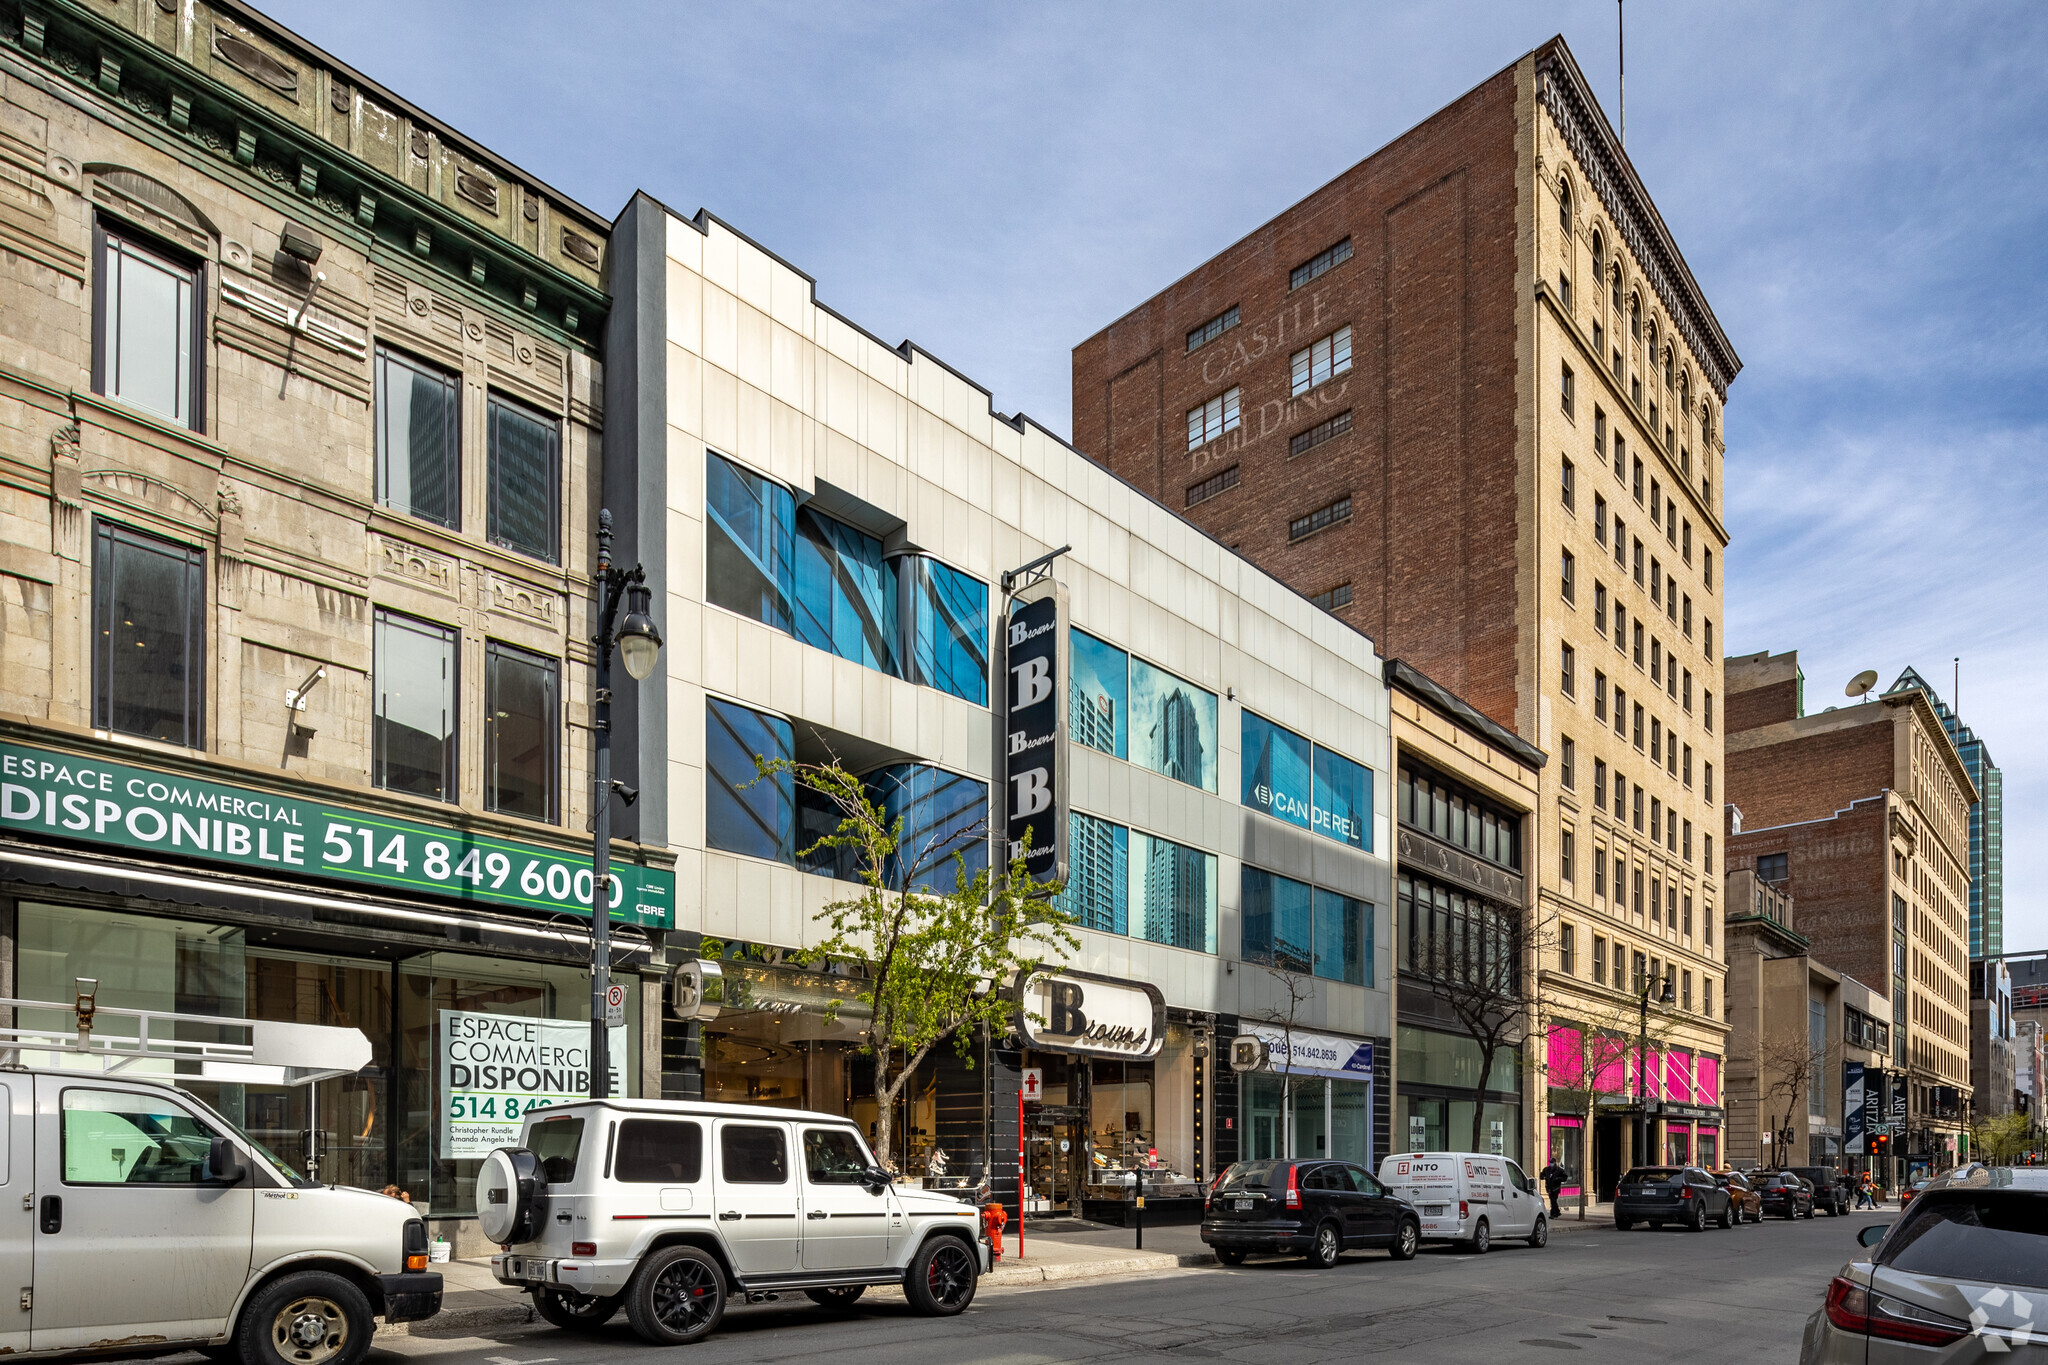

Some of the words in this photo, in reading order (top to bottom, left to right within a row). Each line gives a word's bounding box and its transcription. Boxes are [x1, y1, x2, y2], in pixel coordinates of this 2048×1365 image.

[1008, 620, 1056, 648] Browns
[1011, 655, 1052, 713] B
[1008, 730, 1056, 756] Browns
[3, 754, 113, 792] ESPACE
[126, 778, 303, 827] COMMERCIAL
[1010, 766, 1052, 821] B
[1, 782, 304, 866] DISPONIBLE
[1275, 791, 1360, 840] CANDEREL
[322, 823, 409, 874] 514
[422, 841, 511, 890] 849
[520, 860, 623, 909] 6000
[1008, 839, 1056, 864] Browns
[635, 903, 666, 917] CBRE
[675, 971, 698, 1008] B
[1040, 978, 1148, 1045] Browns
[450, 1016, 536, 1043] ESPACE
[449, 1040, 617, 1069] COMMERCIL
[1292, 1045, 1338, 1061] 514.842.8636
[450, 1063, 619, 1094] DISPONIBE
[449, 1096, 497, 1119] 514
[1866, 1088, 1879, 1135] ARITZIA
[449, 1125, 489, 1136] Christopher
[491, 1126, 514, 1135] Rundle
[449, 1135, 479, 1143] Amanda
[481, 1135, 505, 1145] Angela
[507, 1135, 520, 1143] Her
[1412, 1163, 1438, 1172] INTO
